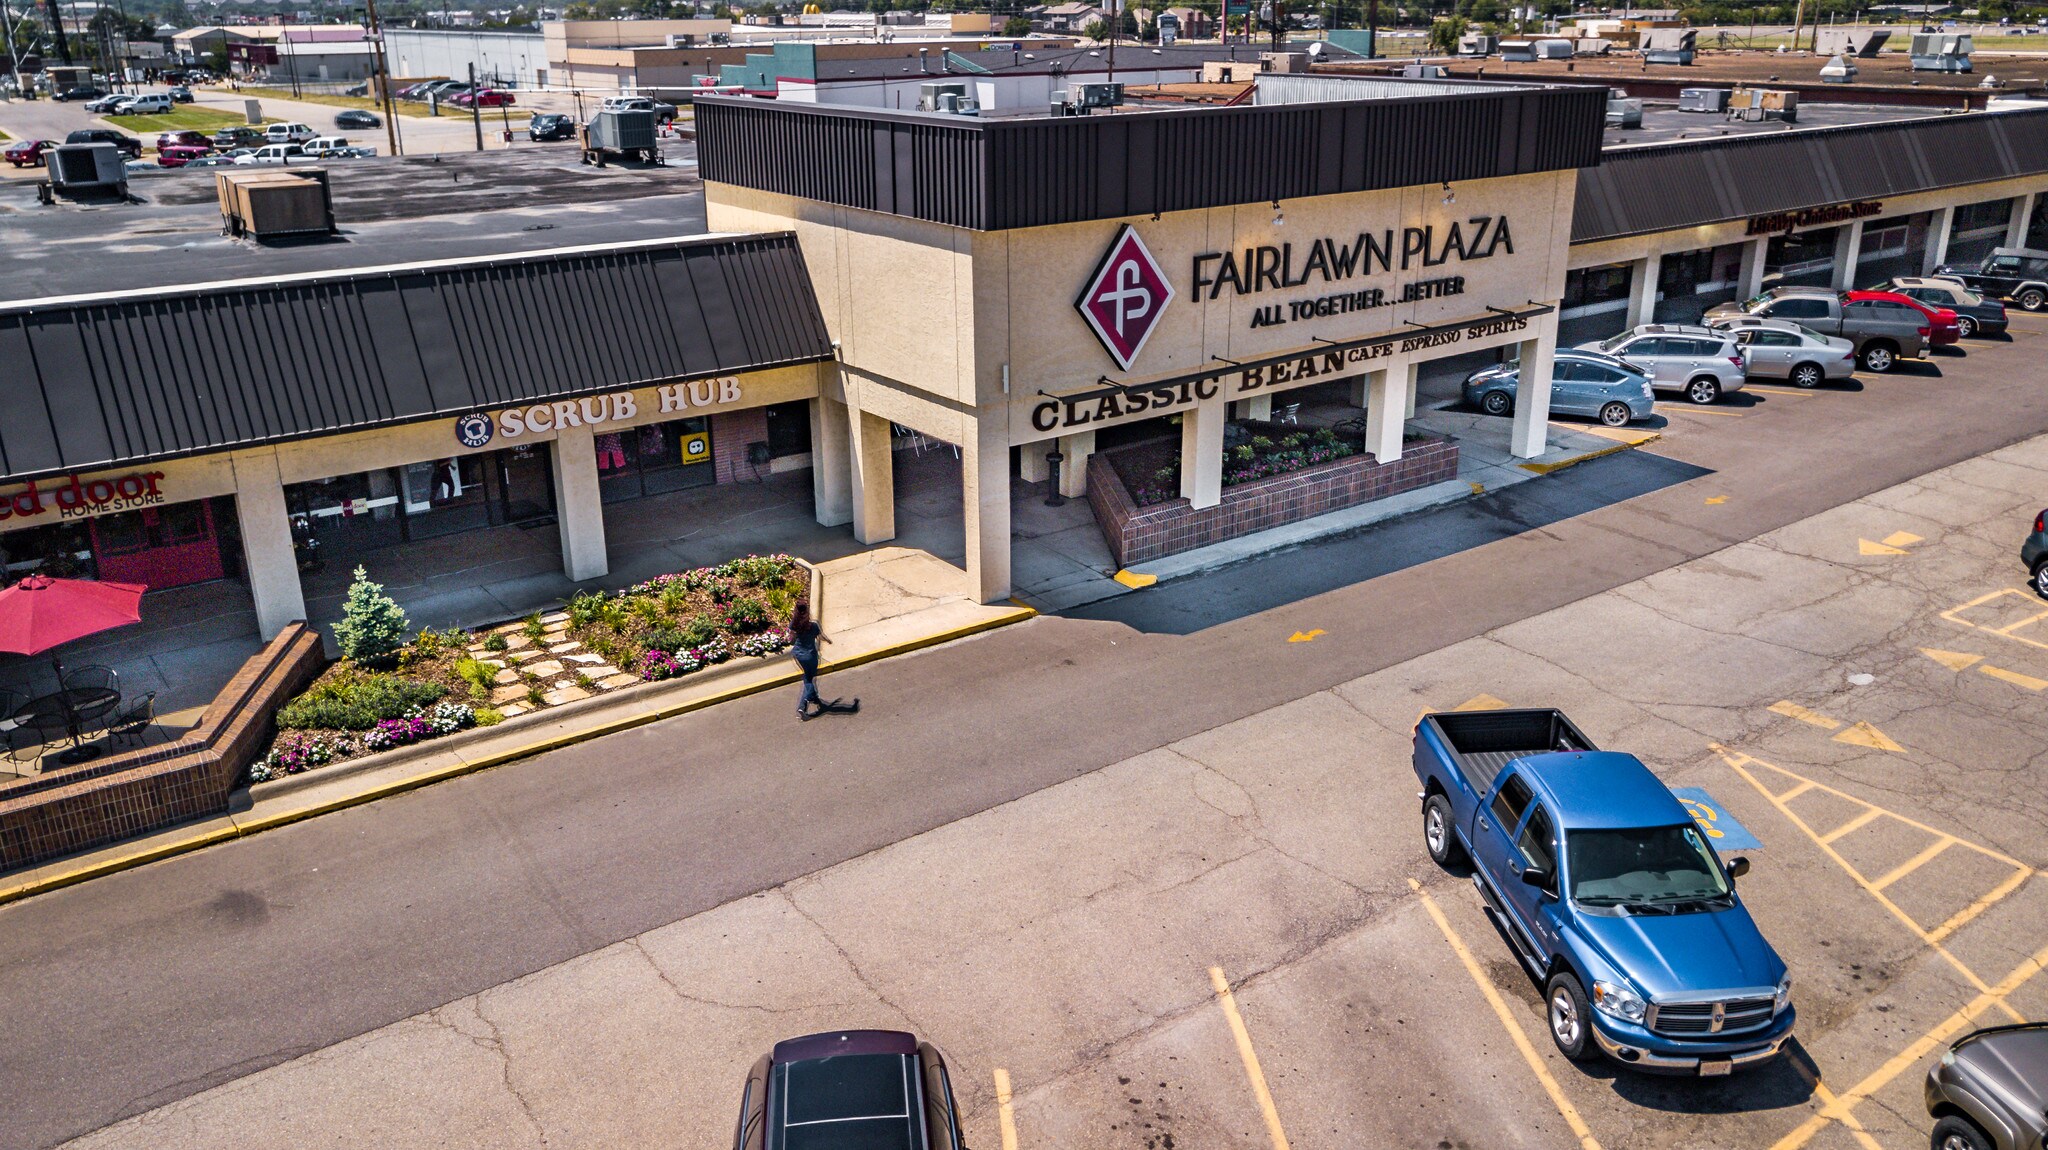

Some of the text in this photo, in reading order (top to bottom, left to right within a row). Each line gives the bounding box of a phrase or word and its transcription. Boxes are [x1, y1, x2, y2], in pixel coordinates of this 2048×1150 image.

[1192, 215, 1514, 303] FAIRLAWN PLAZA
[1250, 304, 1286, 329] ALL
[1032, 317, 1528, 432] CLASSIC BEAN CAFE ESPRESSO SPIRITS
[460, 413, 489, 426] SCRUB
[500, 375, 743, 438] SCRUB HUB
[463, 434, 489, 446] HUB
[55, 470, 165, 510] door
[61, 493, 165, 519] HOME STORE
